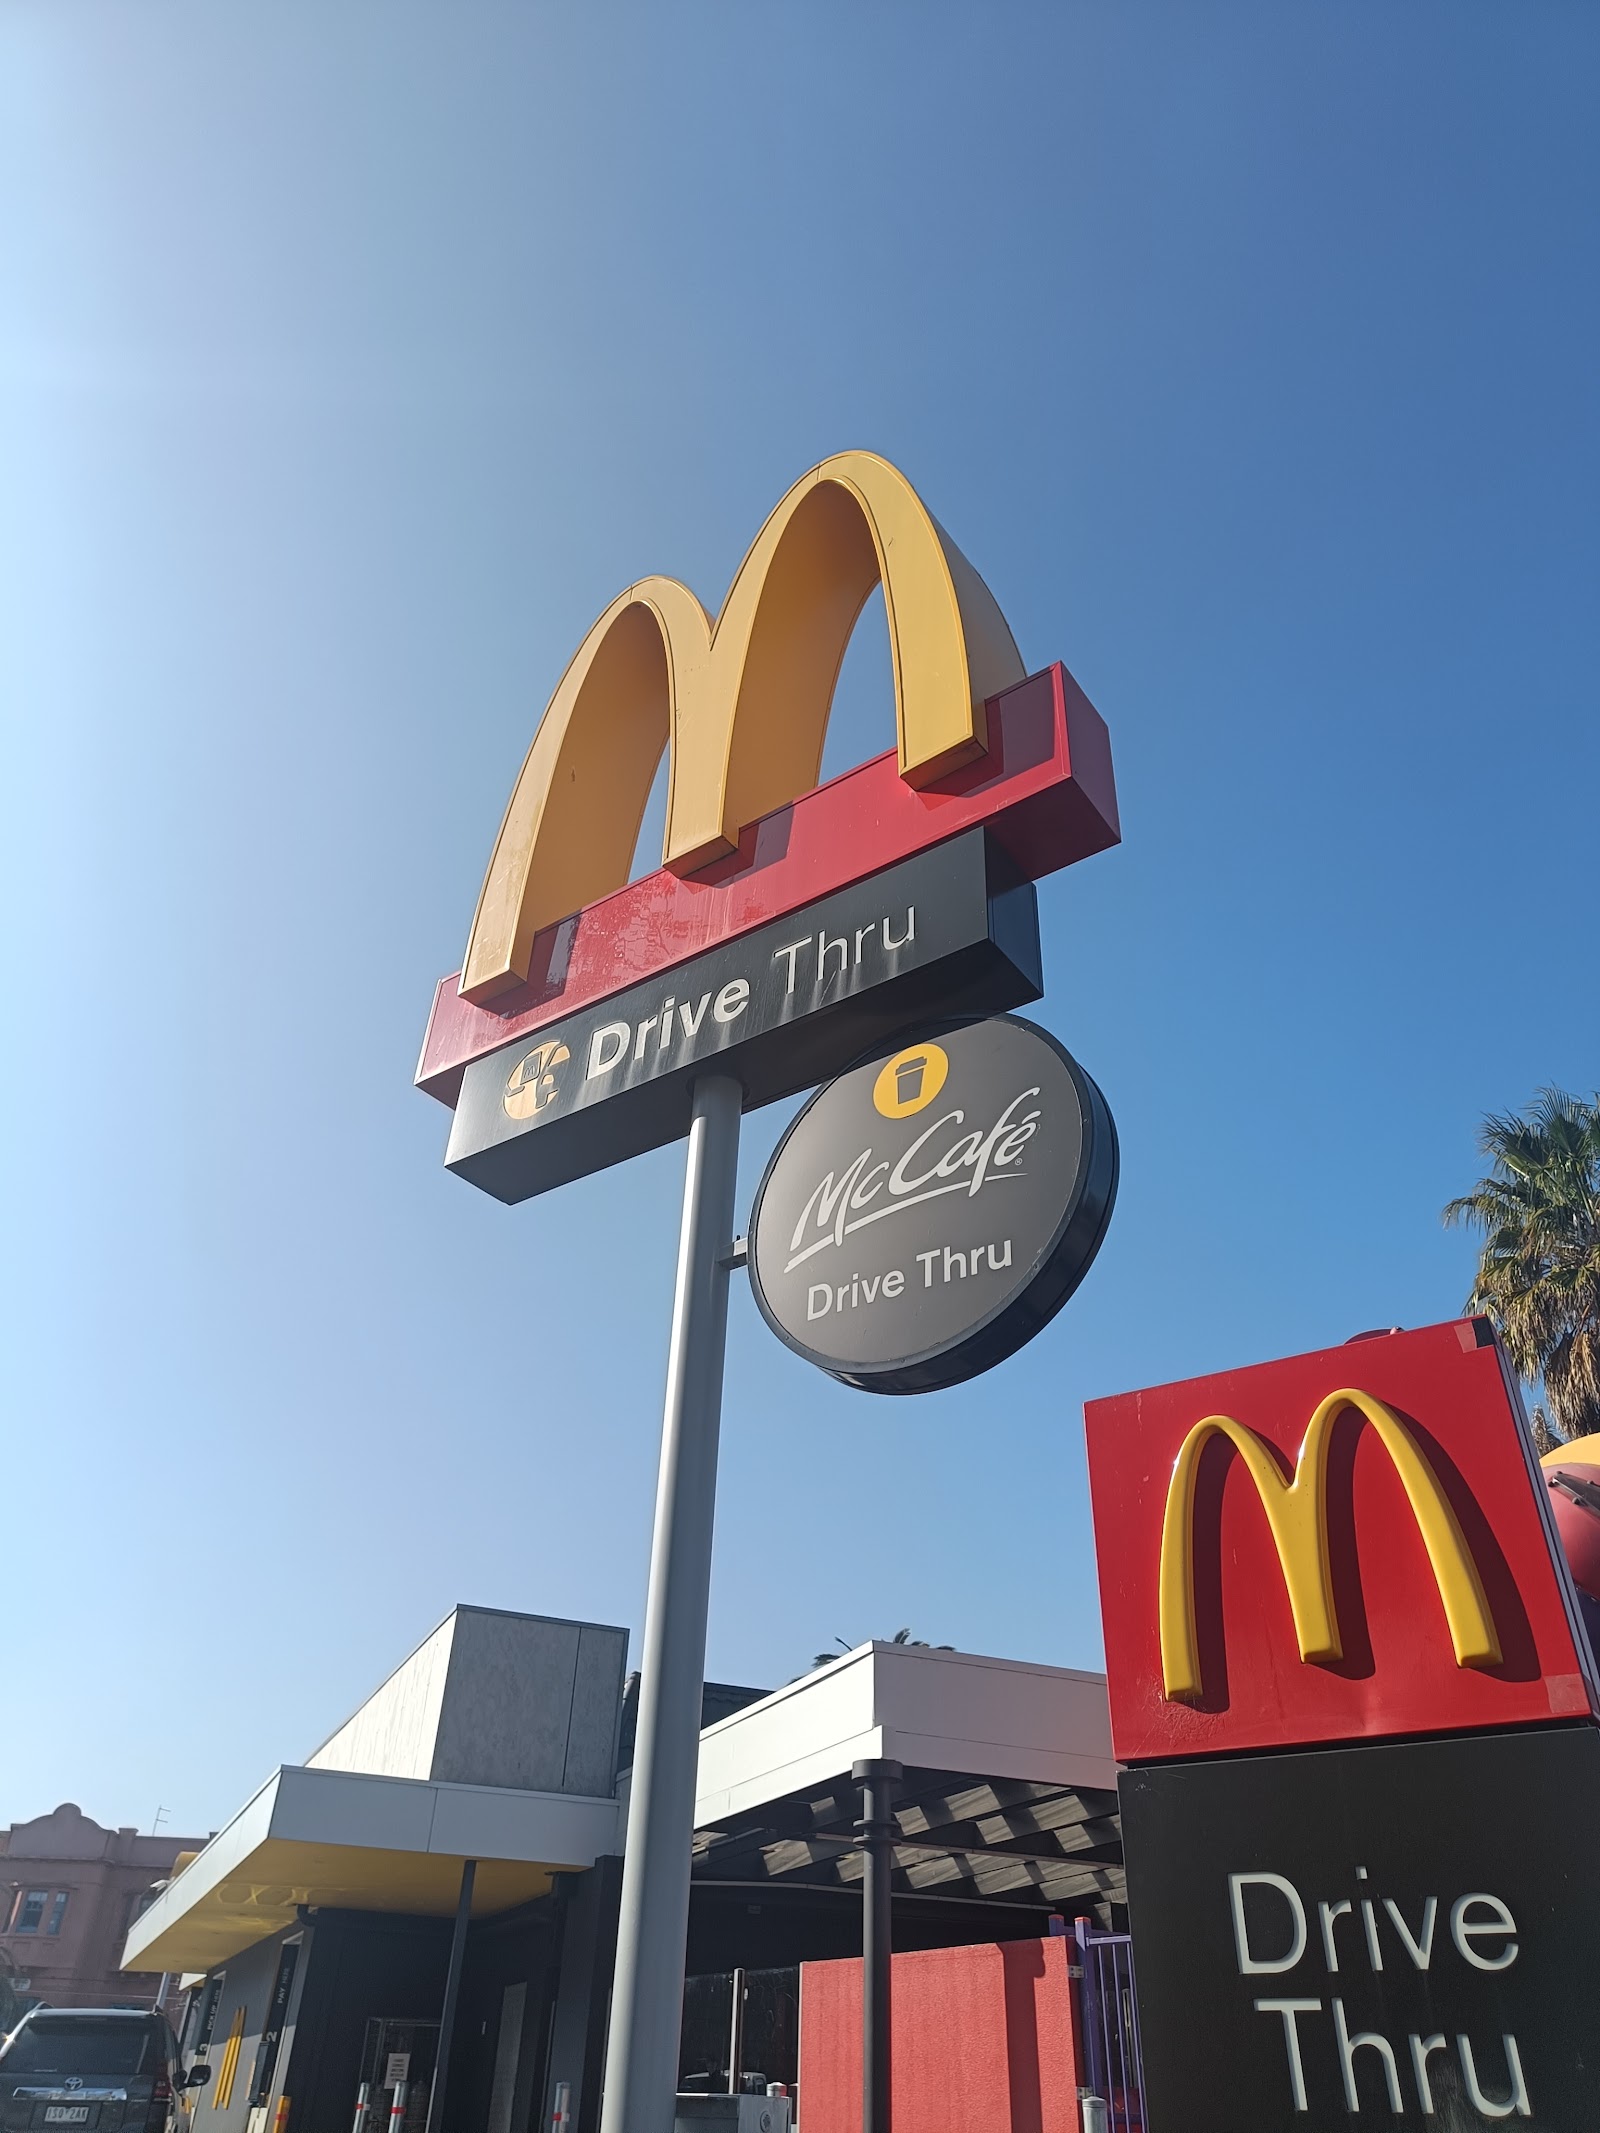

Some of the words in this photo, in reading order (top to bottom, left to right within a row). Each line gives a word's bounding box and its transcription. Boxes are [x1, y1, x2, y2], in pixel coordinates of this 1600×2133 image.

[585, 977, 750, 1081] Drive
[773, 904, 916, 995] Thru
[807, 1268, 906, 1322] Drive
[915, 1239, 1013, 1289] Thru
[1226, 1865, 1519, 1977] Drive
[266, 2031, 278, 2043] 2
[1253, 1996, 1533, 2119] Thru
